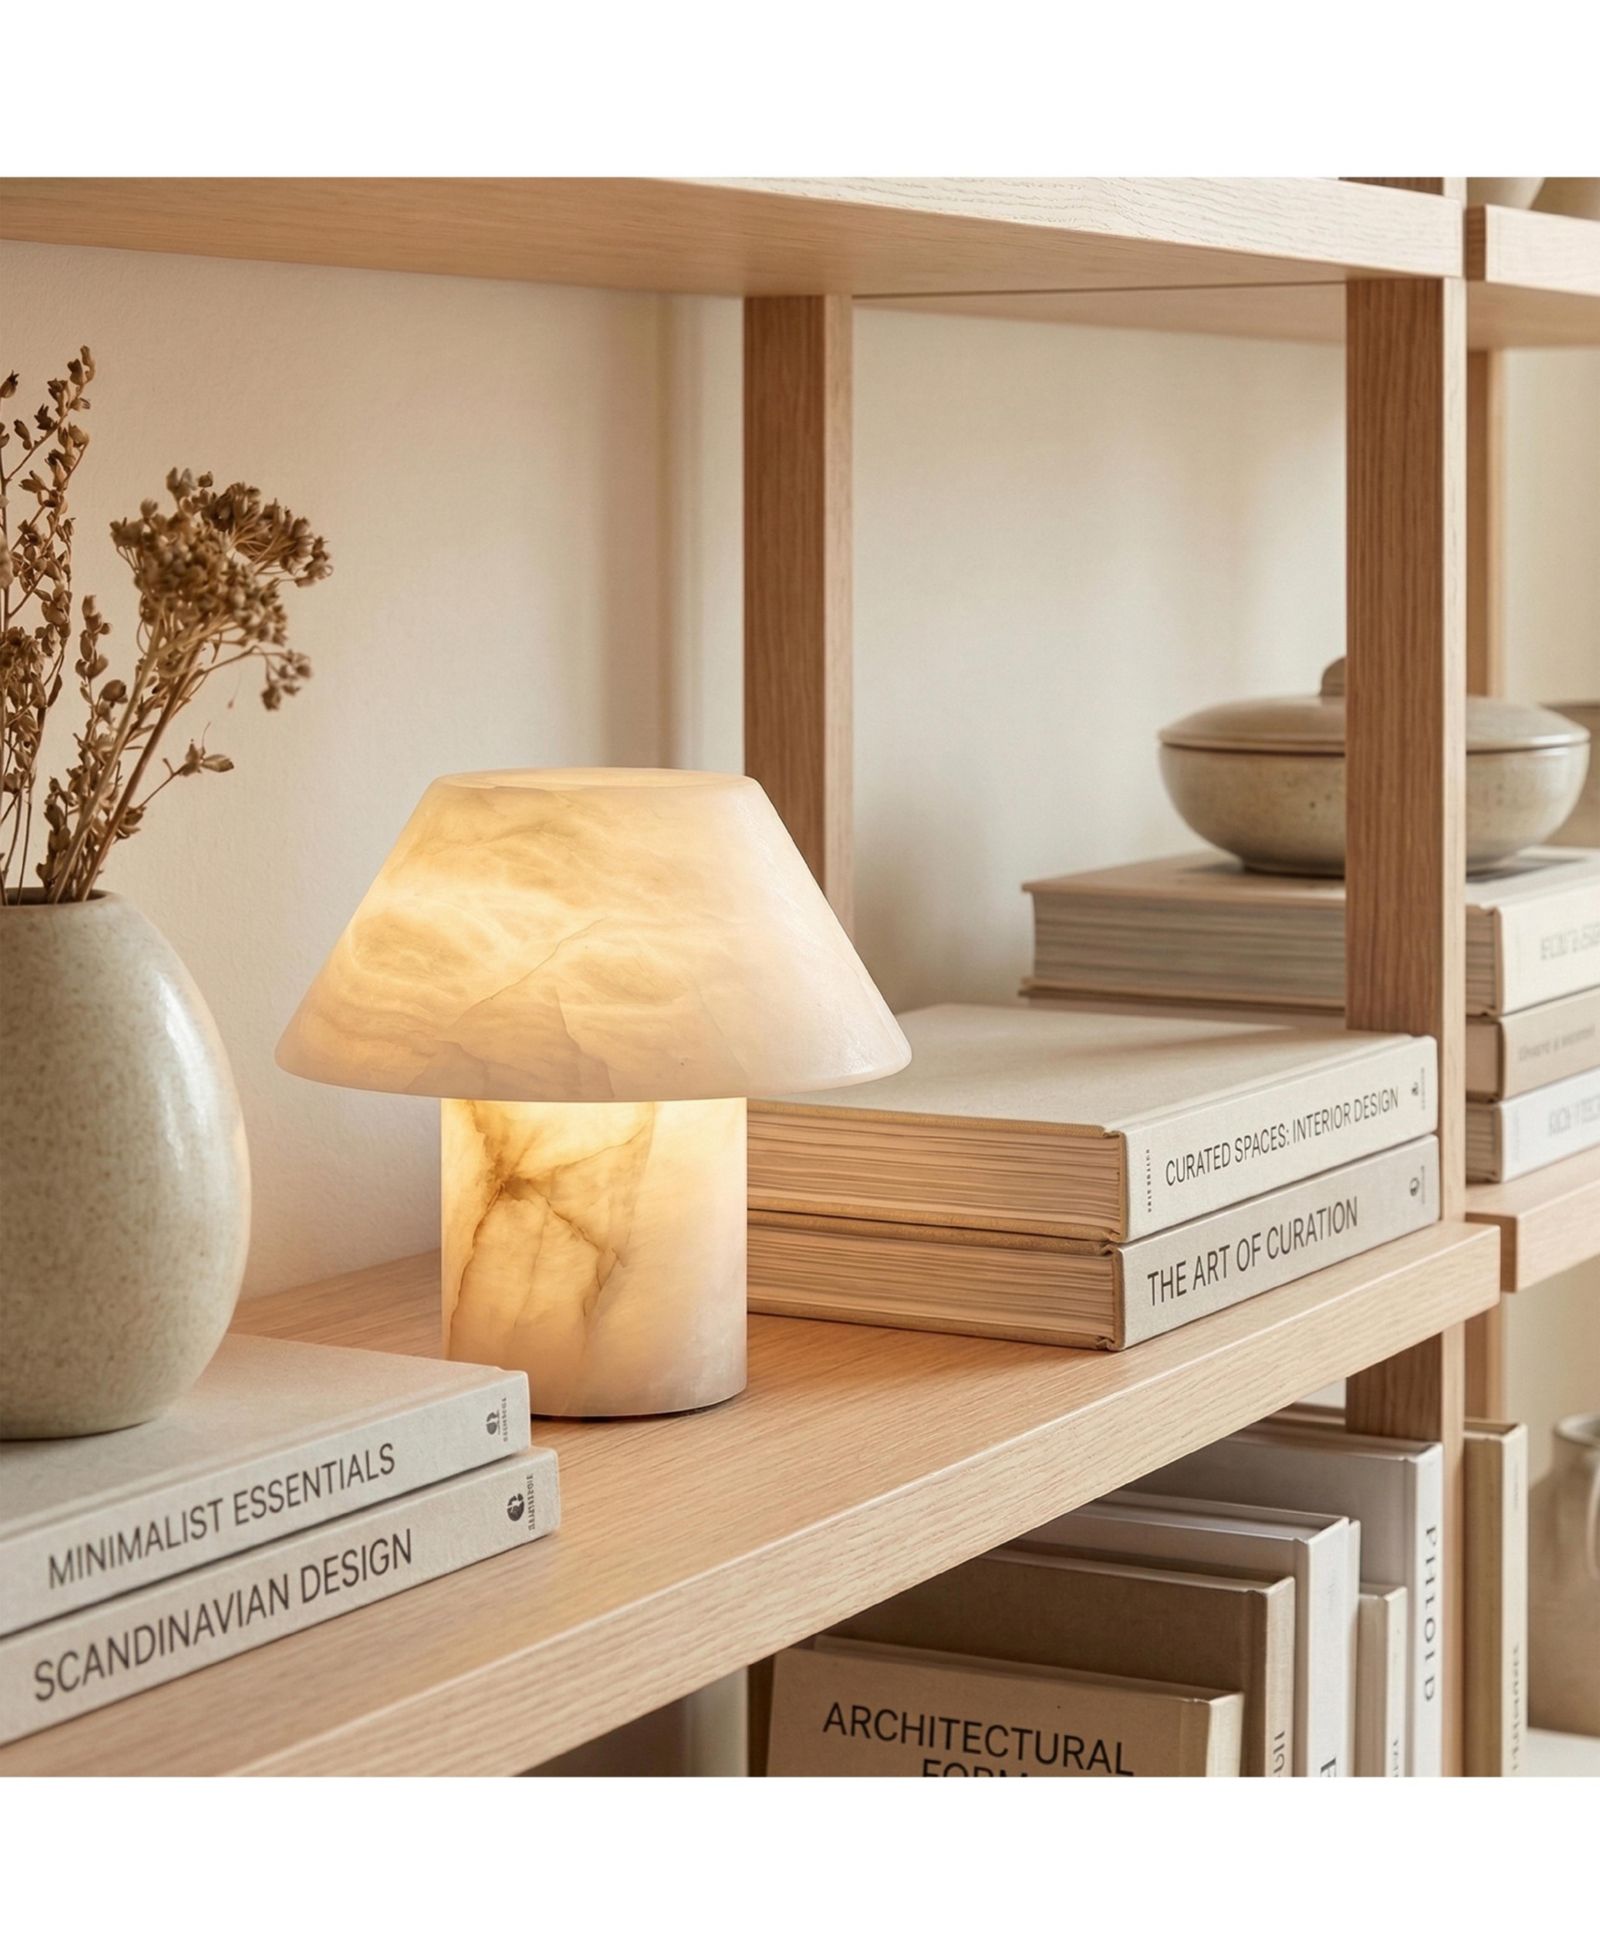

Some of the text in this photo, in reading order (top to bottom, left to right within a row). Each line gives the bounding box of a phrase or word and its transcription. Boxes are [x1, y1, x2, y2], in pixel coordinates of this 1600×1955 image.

[1165, 1142, 1231, 1187] CURATED
[1234, 1123, 1290, 1163] SPACES:
[1292, 1102, 1351, 1143] INTERIOR
[1353, 1087, 1400, 1124] DESIGN
[1147, 1195, 1358, 1306] THE ART OF CURATION
[48, 1442, 396, 1589] MINIMALIST ESSENTIALS
[34, 1528, 412, 1702] SCANDINAVIAN DESIGN
[822, 1701, 1135, 1777] ARCHITECTURAL
